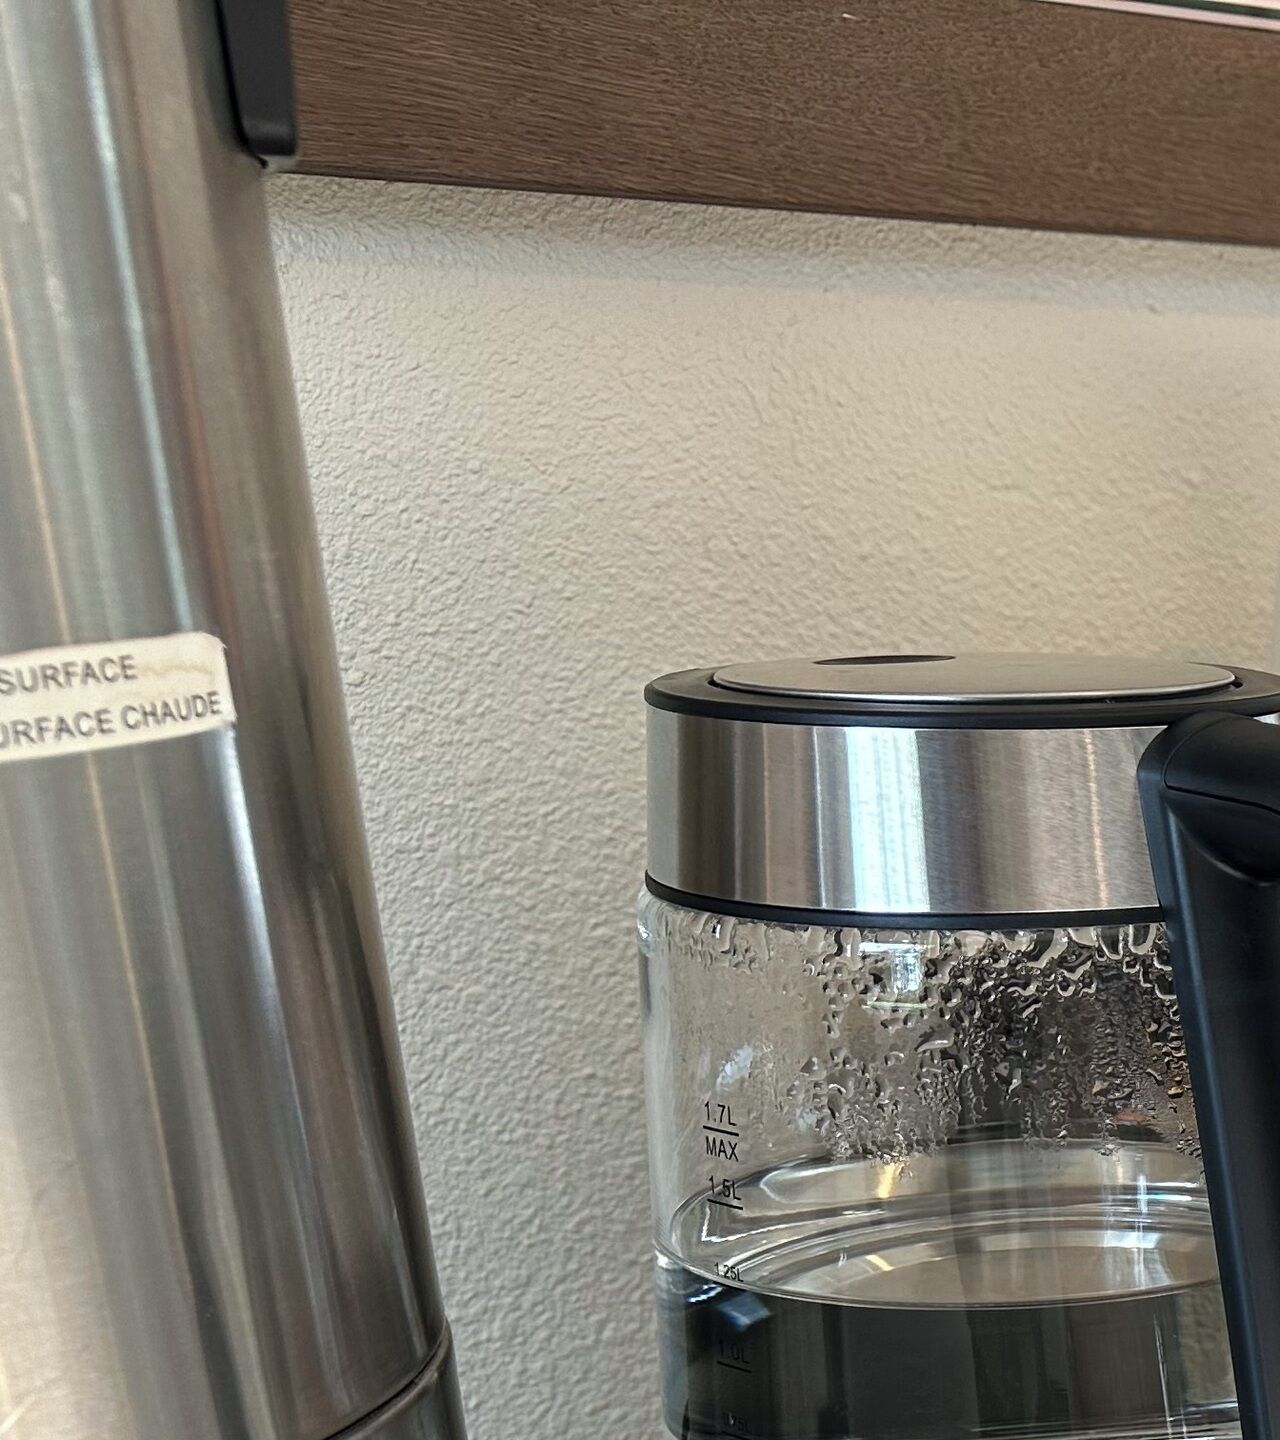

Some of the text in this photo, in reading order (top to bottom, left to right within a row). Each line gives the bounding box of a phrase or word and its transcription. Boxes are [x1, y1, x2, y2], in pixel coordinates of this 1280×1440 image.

[0, 654, 138, 695] SURFACE
[120, 690, 222, 730] CHAUDE
[704, 1101, 738, 1127] 1.7L
[705, 1136, 740, 1162] MAX
